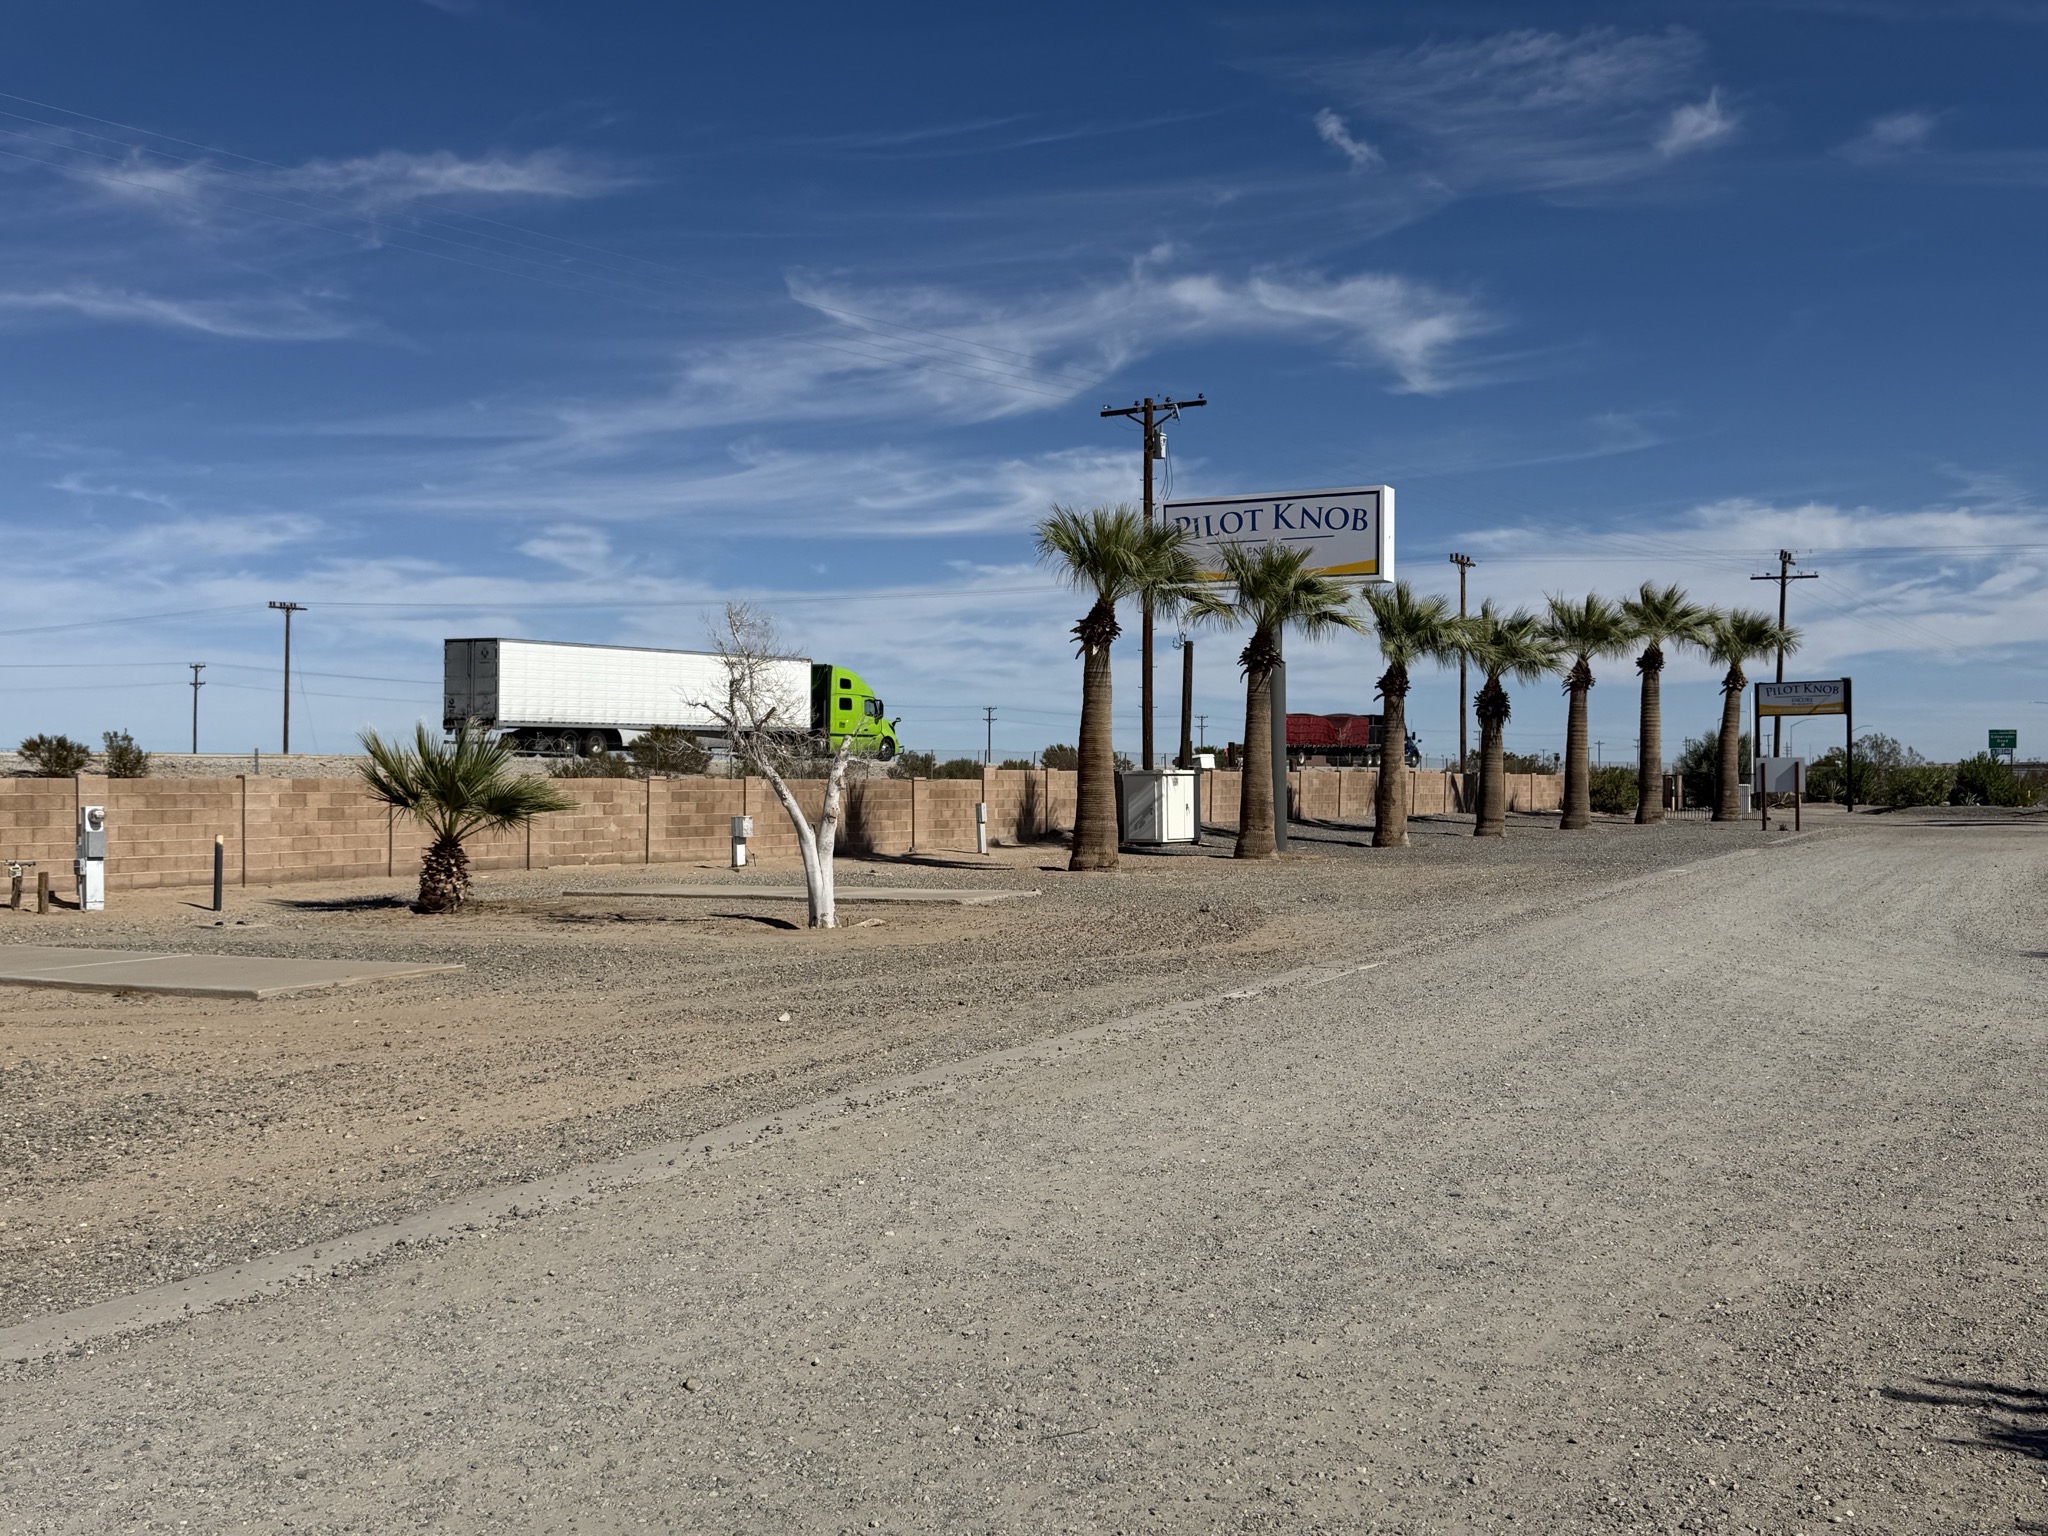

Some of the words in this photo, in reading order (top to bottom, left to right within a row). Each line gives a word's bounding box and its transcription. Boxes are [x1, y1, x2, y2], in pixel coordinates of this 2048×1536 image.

[1173, 509, 1263, 539] PILOT
[1272, 503, 1368, 531] KNOB
[1766, 685, 1800, 697] PILOT
[1804, 683, 1839, 695] KNOB
